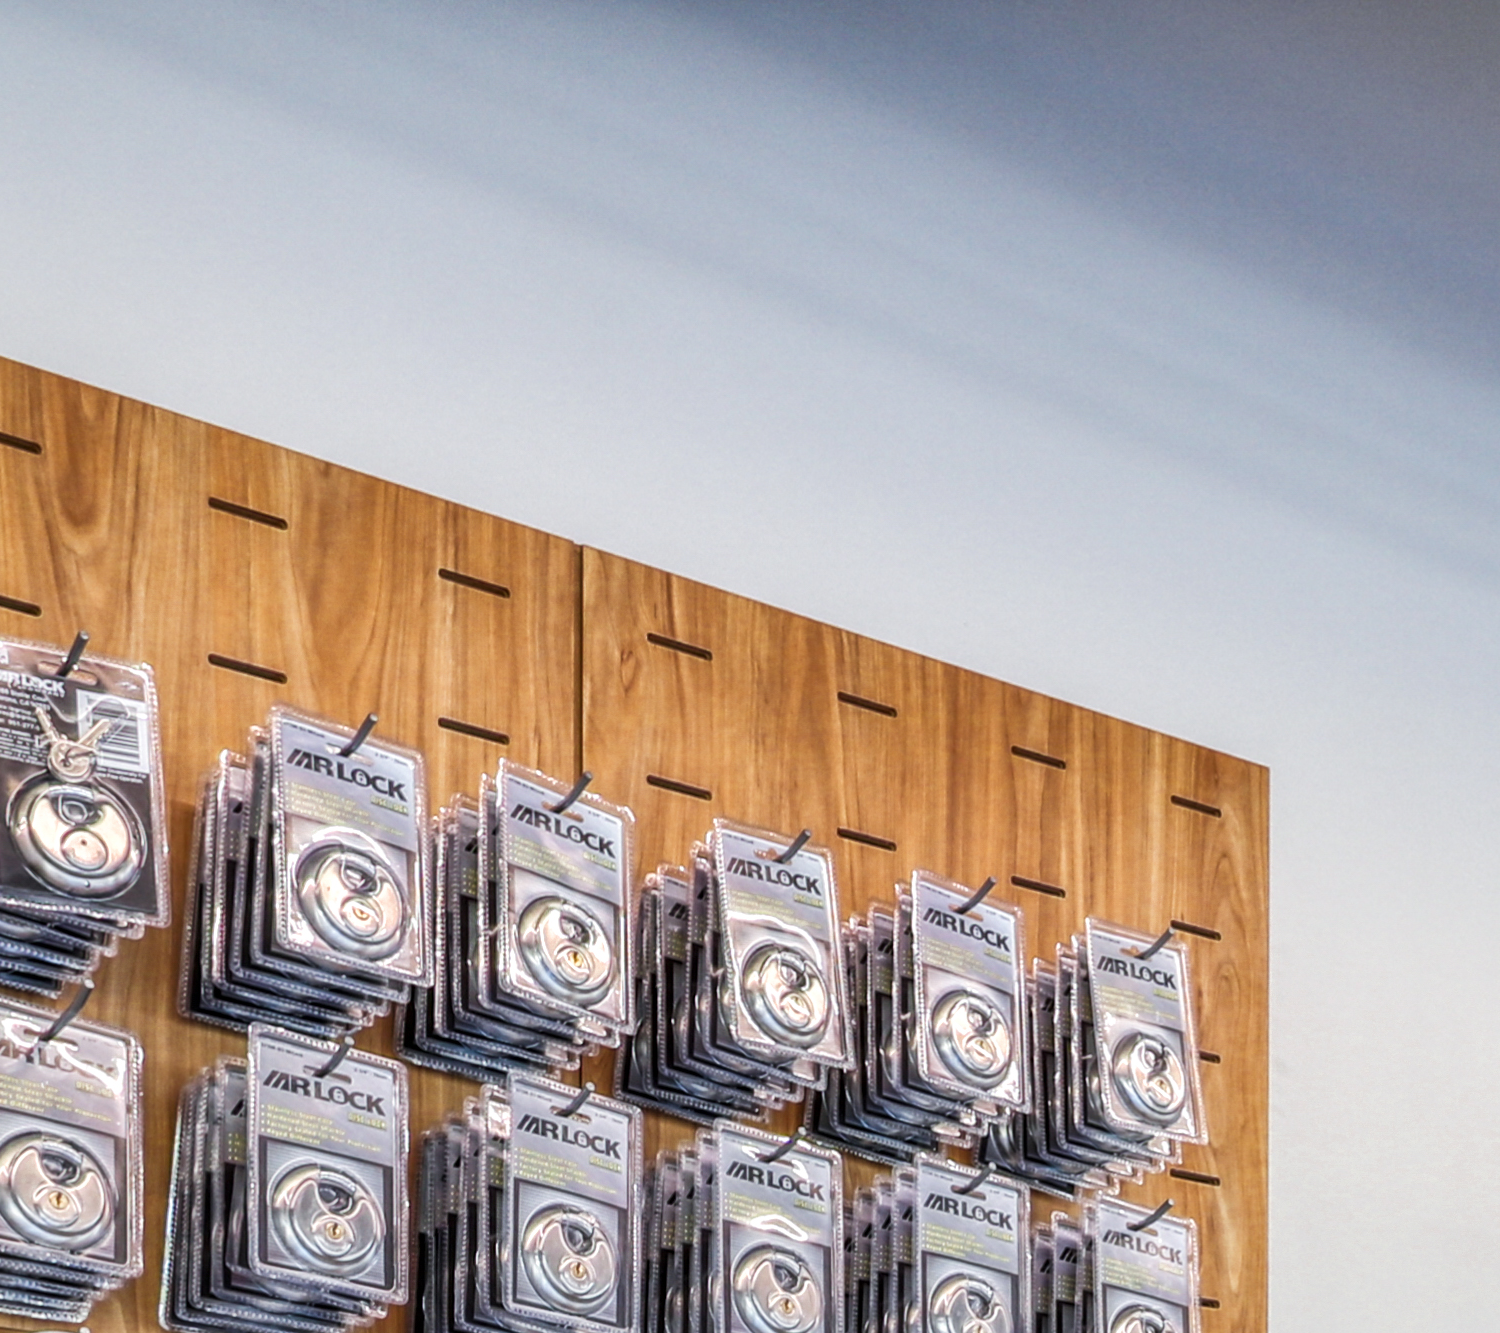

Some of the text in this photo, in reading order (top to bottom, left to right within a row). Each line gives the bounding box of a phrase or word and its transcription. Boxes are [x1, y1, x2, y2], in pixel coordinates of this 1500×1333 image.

[337, 761, 407, 801] LOCK
[554, 820, 616, 859] LOCK
[314, 1080, 386, 1116] LOCK
[560, 1126, 621, 1161] LOCK
